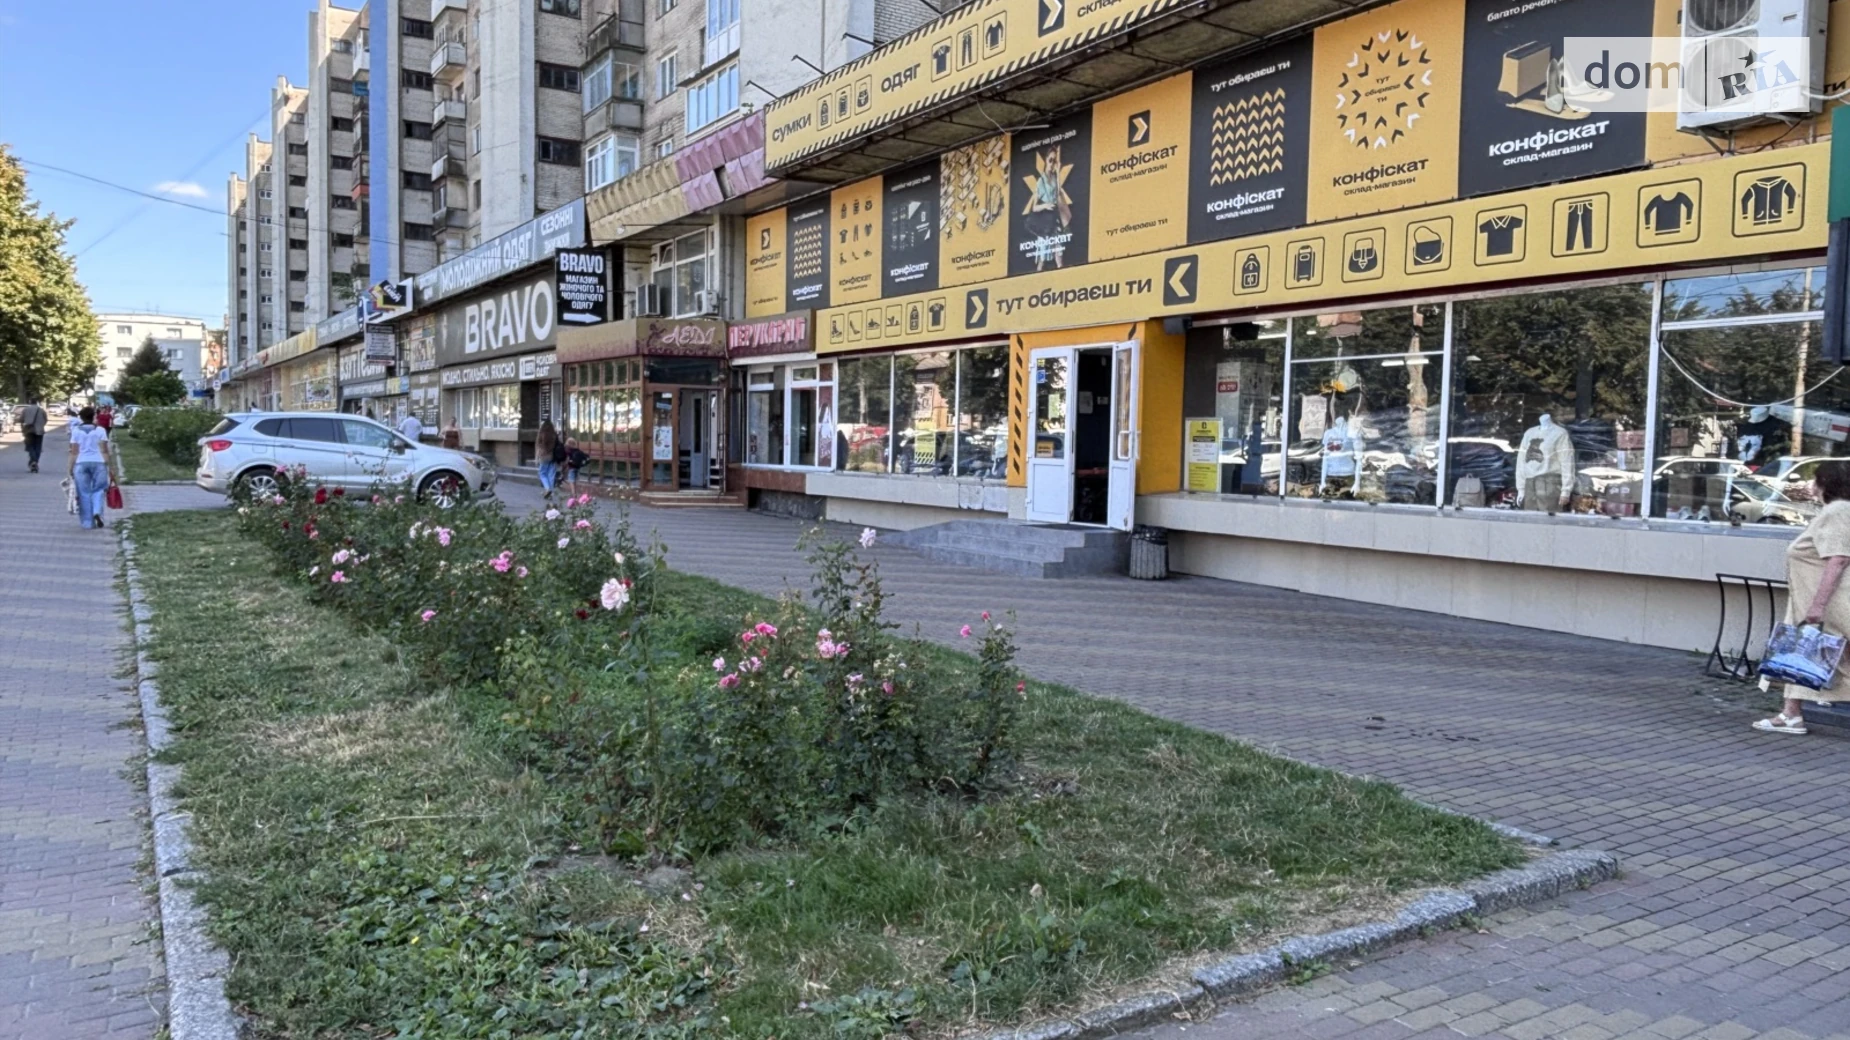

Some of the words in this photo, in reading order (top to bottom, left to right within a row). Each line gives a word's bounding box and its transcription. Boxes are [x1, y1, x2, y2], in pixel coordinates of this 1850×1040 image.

[1487, 6, 1520, 22] багато
[1210, 80, 1227, 92] тут
[1277, 60, 1290, 71] ти
[1376, 76, 1390, 84] тут
[1489, 120, 1610, 156] конфіскат
[1100, 145, 1178, 175] конфіскат
[1503, 142, 1593, 166] склад-магазин
[1110, 164, 1168, 184] склад-магазин
[1333, 159, 1429, 187] конфіскат
[1344, 177, 1416, 196] склад-магазин
[1206, 187, 1285, 214] конфіскат
[1215, 203, 1274, 220] склад-магазин
[540, 207, 573, 236] СЕЗОННІ
[1106, 228, 1118, 236] тут
[1020, 233, 1073, 251] конфіскат
[442, 238, 501, 293] МОЛОДІЖНИЙ
[502, 230, 532, 268] ОДЯГ
[560, 252, 604, 274] BRAVO
[951, 249, 996, 264] конфіскат
[890, 262, 930, 276] конфіскат
[560, 282, 594, 294] ЖІНОЧОГО
[596, 285, 604, 293] ТА
[566, 274, 598, 284] МАГАЗИН
[562, 292, 603, 302] ЧОЛОВІЧОГО
[572, 300, 594, 310] ОДЯГУ
[996, 296, 1024, 315] тут
[1028, 282, 1120, 308] обираєш
[1126, 278, 1152, 294] ти
[465, 280, 554, 354] BRAVO
